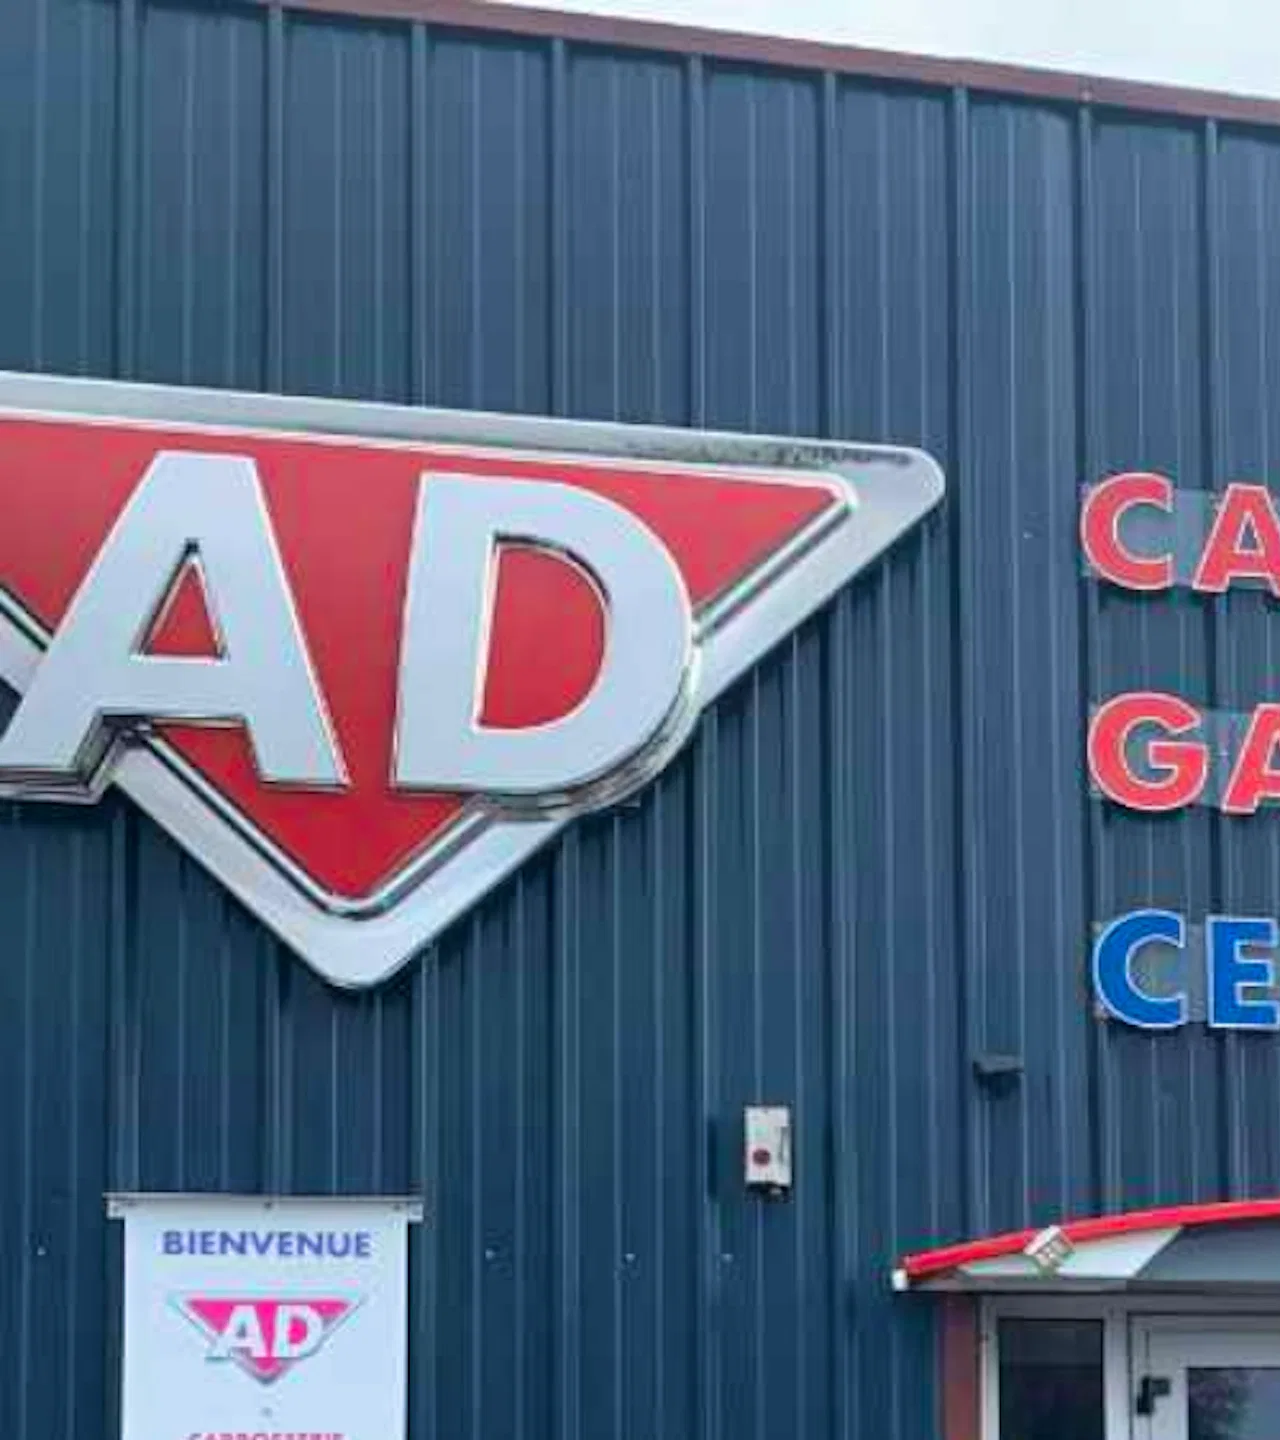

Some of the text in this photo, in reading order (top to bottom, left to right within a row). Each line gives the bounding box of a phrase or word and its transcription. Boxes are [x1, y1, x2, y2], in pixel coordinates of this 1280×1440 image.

[0, 450, 695, 798] AD
[161, 1230, 373, 1258] BIENVENUE
[205, 1304, 323, 1358] AD
